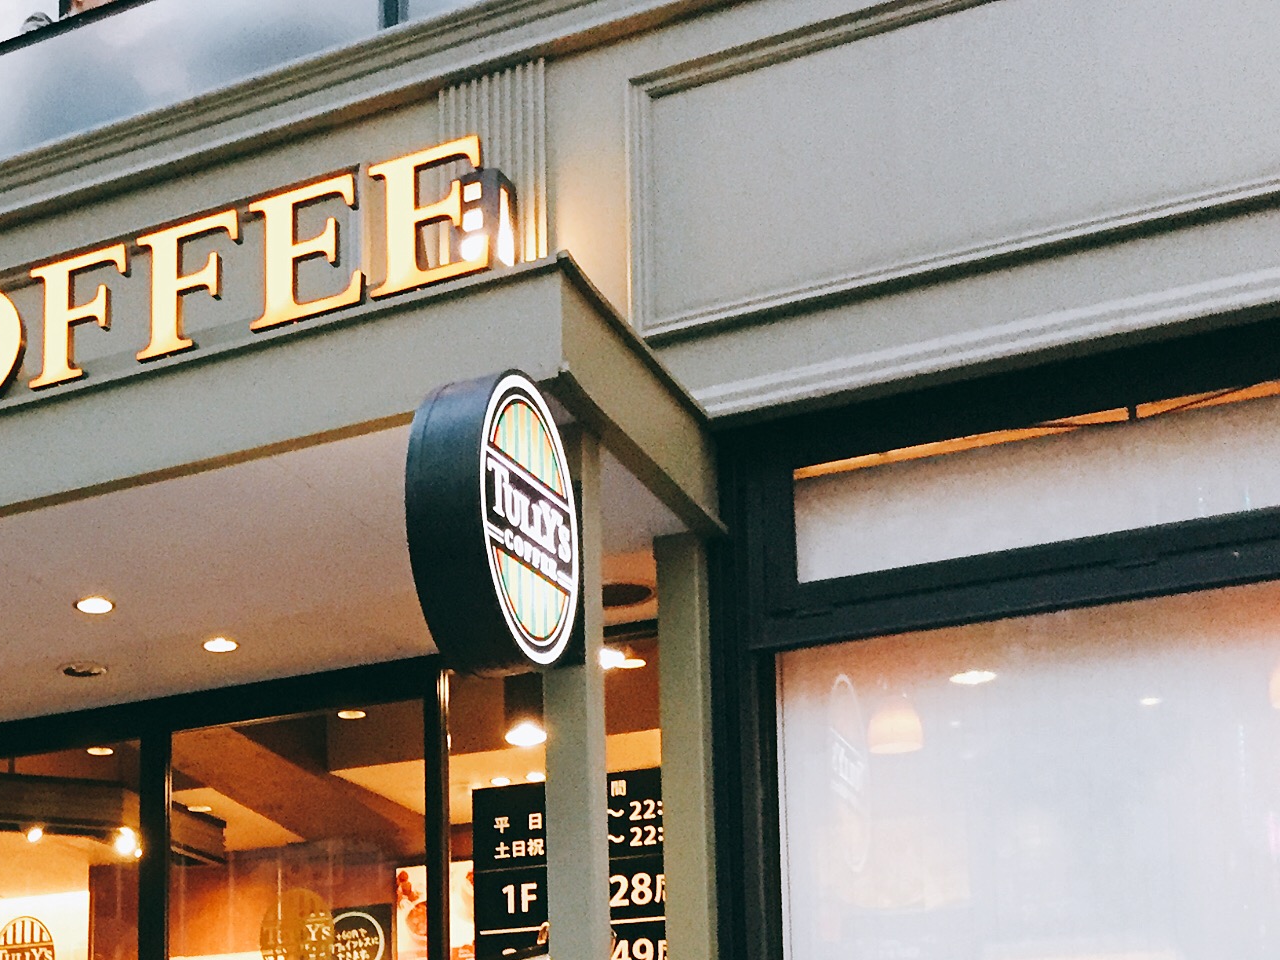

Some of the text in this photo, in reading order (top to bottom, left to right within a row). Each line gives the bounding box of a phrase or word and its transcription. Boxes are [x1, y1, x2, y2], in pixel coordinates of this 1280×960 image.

[486, 456, 572, 563] TULLY'S
[493, 838, 545, 859] 土日祝
[501, 882, 538, 914] 1F
